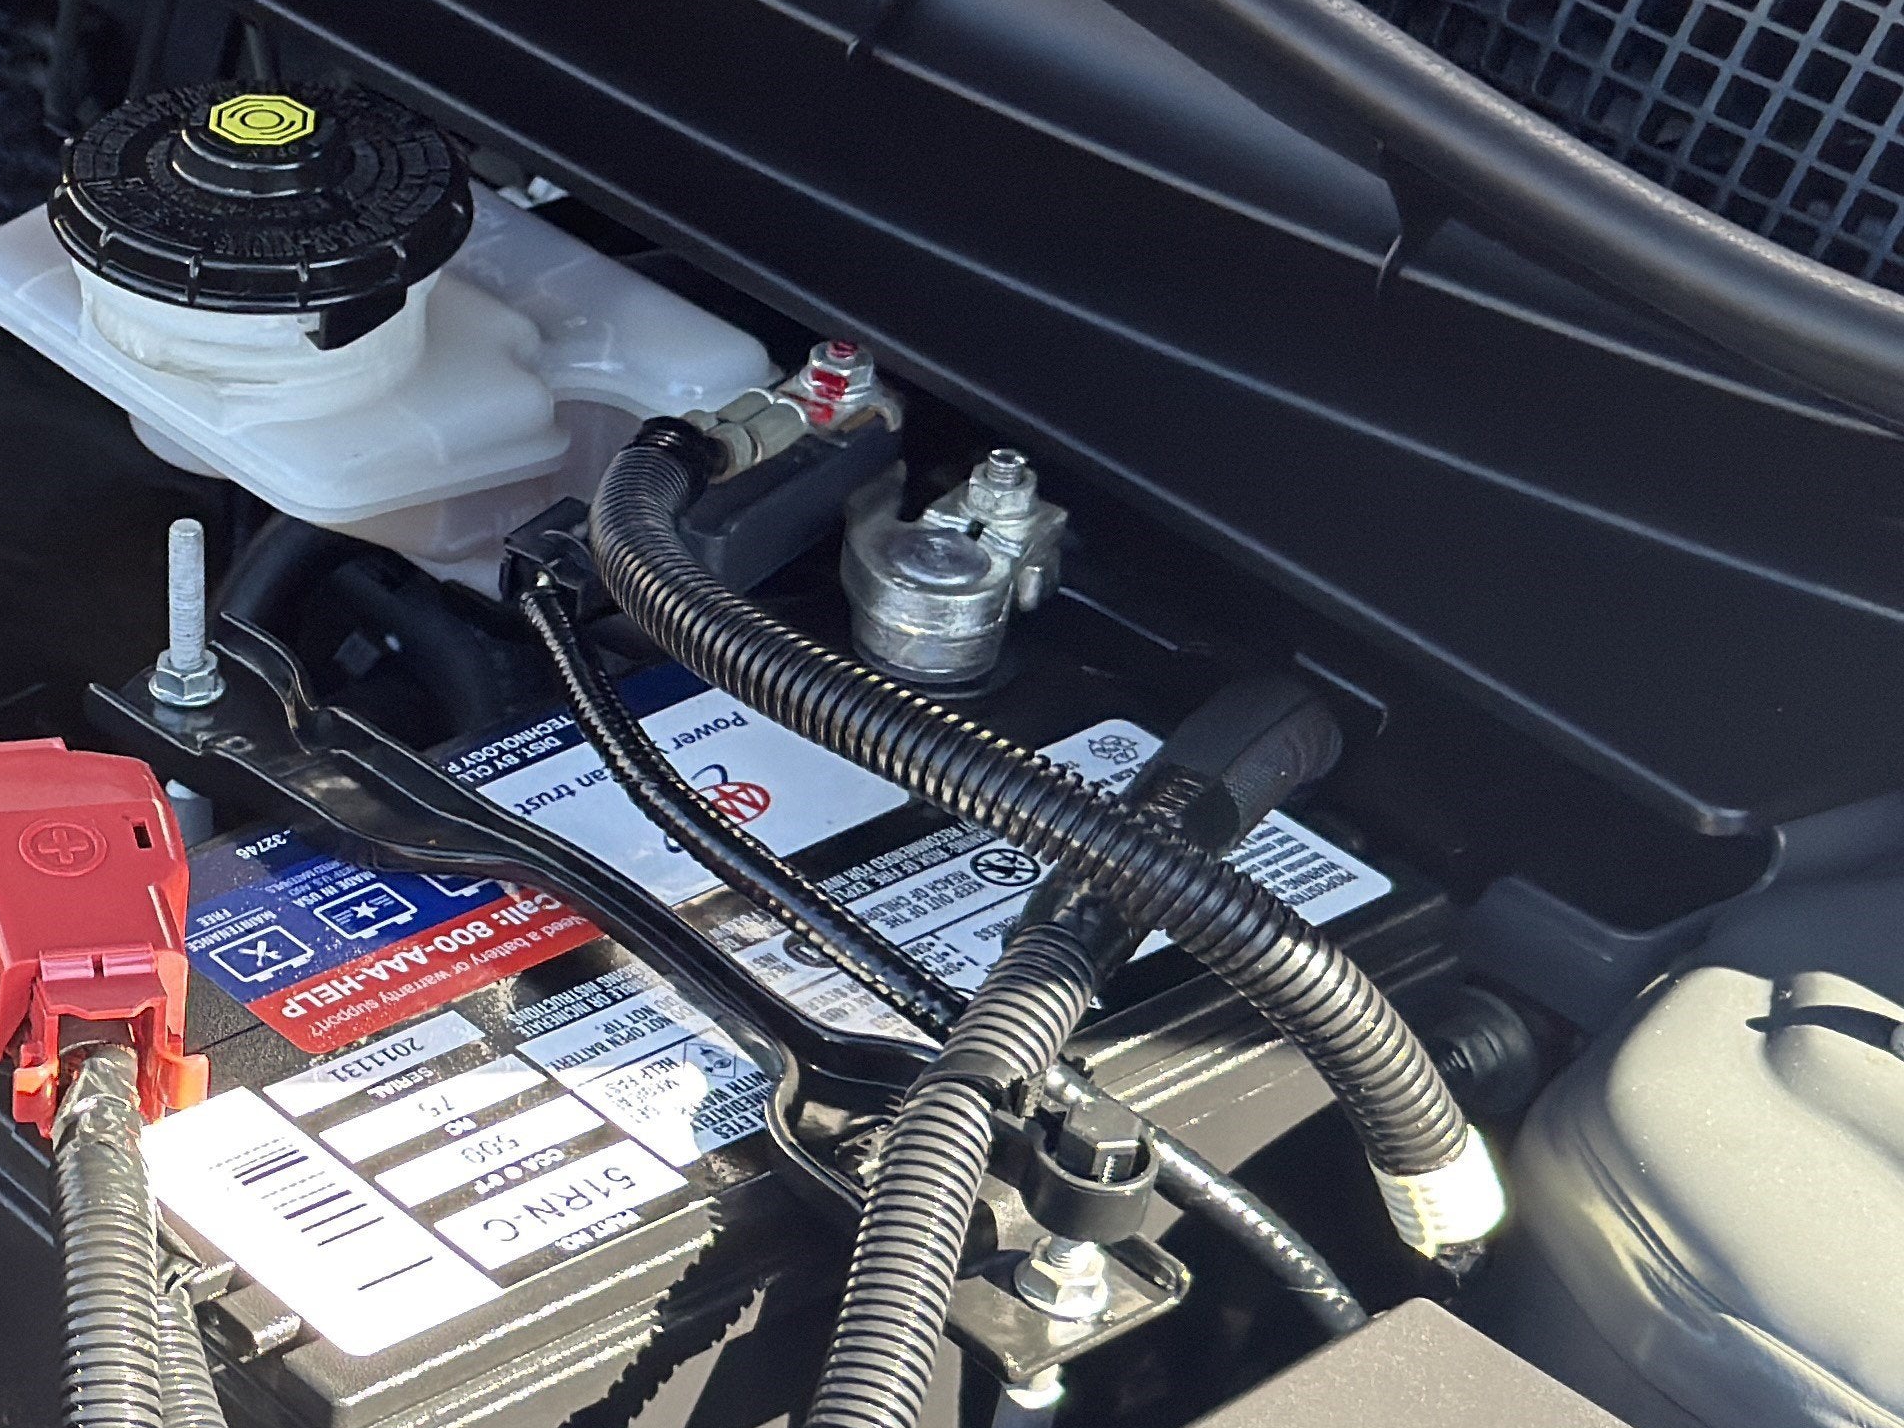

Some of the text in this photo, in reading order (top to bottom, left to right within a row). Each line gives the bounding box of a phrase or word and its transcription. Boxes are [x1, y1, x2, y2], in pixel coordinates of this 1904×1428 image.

[453, 713, 577, 768] TECHNOLOGY
[662, 709, 752, 752] Power
[487, 751, 523, 770] BY
[512, 734, 564, 760] DIST.
[509, 781, 581, 817] trust
[229, 831, 291, 861] 32746
[865, 824, 965, 872] RECOMMENDED
[912, 846, 950, 867] RISK
[840, 862, 877, 882] FOR
[895, 858, 922, 874] OF
[288, 868, 378, 909] MADE IN USA
[904, 886, 931, 902] OF
[922, 868, 973, 894] REACH
[192, 906, 234, 928] FREE
[878, 877, 988, 930] KEEP OUT OF THE
[181, 908, 280, 953] MAINTENANCE
[522, 929, 543, 942] a
[269, 890, 564, 1021] Call: 800-AAA-HELP
[463, 933, 533, 968] battery
[445, 958, 474, 975] or
[372, 965, 454, 1005] warranty
[583, 991, 614, 1009] OR
[297, 994, 385, 1038] support?
[618, 1003, 658, 1025] NOT
[637, 1012, 675, 1033] NOT
[601, 1024, 647, 1049] OPEN
[325, 1035, 427, 1085] 2011131
[541, 1039, 611, 1074] BATTERY.
[632, 1054, 682, 1081] HELP
[722, 1069, 772, 1096] WITH
[708, 1113, 759, 1141] EYES
[475, 1163, 640, 1246] 51RN-C
